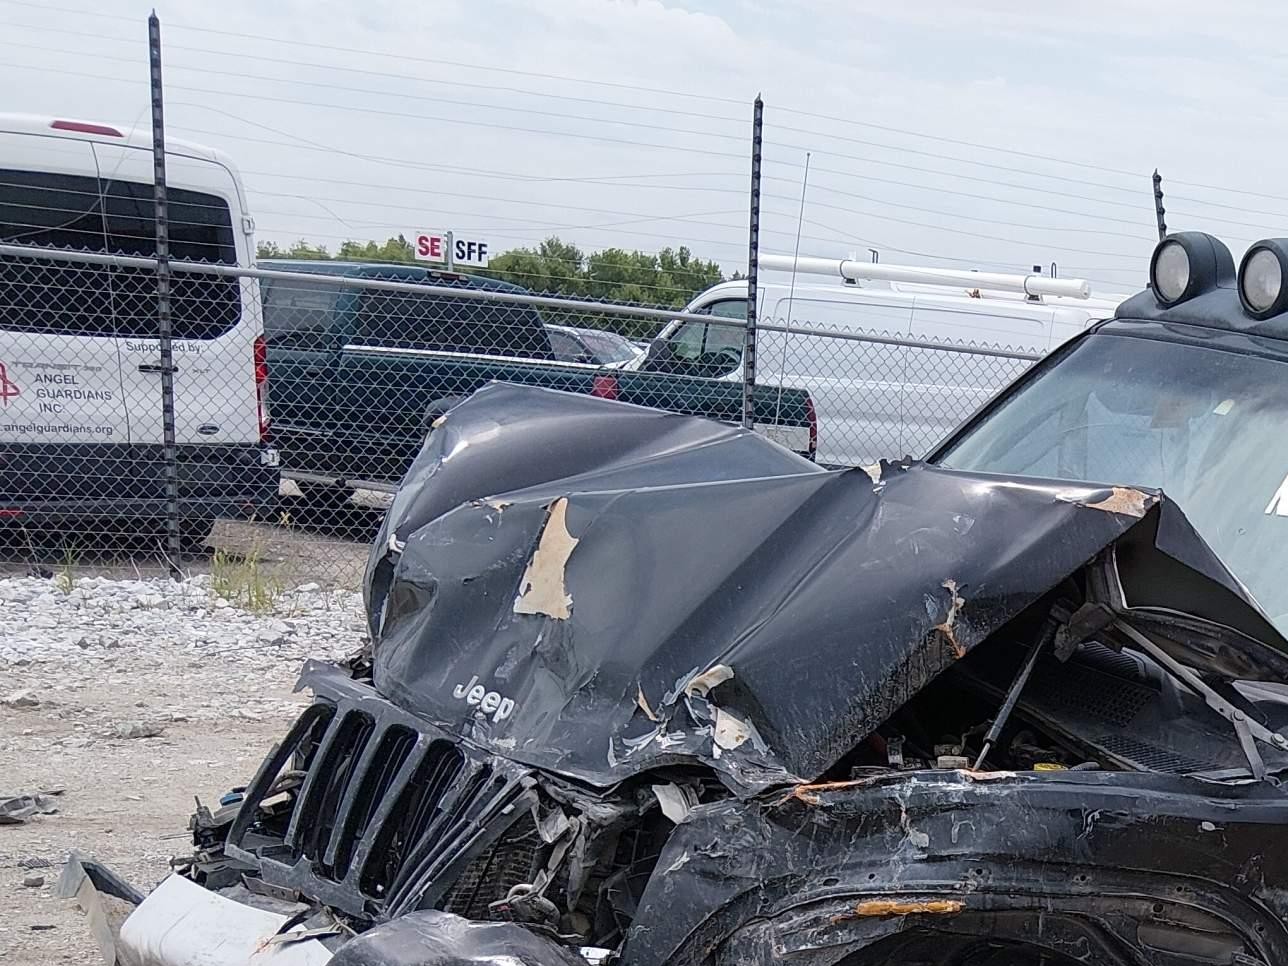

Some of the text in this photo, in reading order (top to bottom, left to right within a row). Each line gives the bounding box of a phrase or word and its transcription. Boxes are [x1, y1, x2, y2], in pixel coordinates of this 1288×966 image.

[417, 235, 442, 257] SE
[455, 239, 488, 262] SFF
[34, 373, 80, 385] ANGEL
[37, 388, 112, 401] GUARDIANS
[453, 675, 515, 723] Jeep
